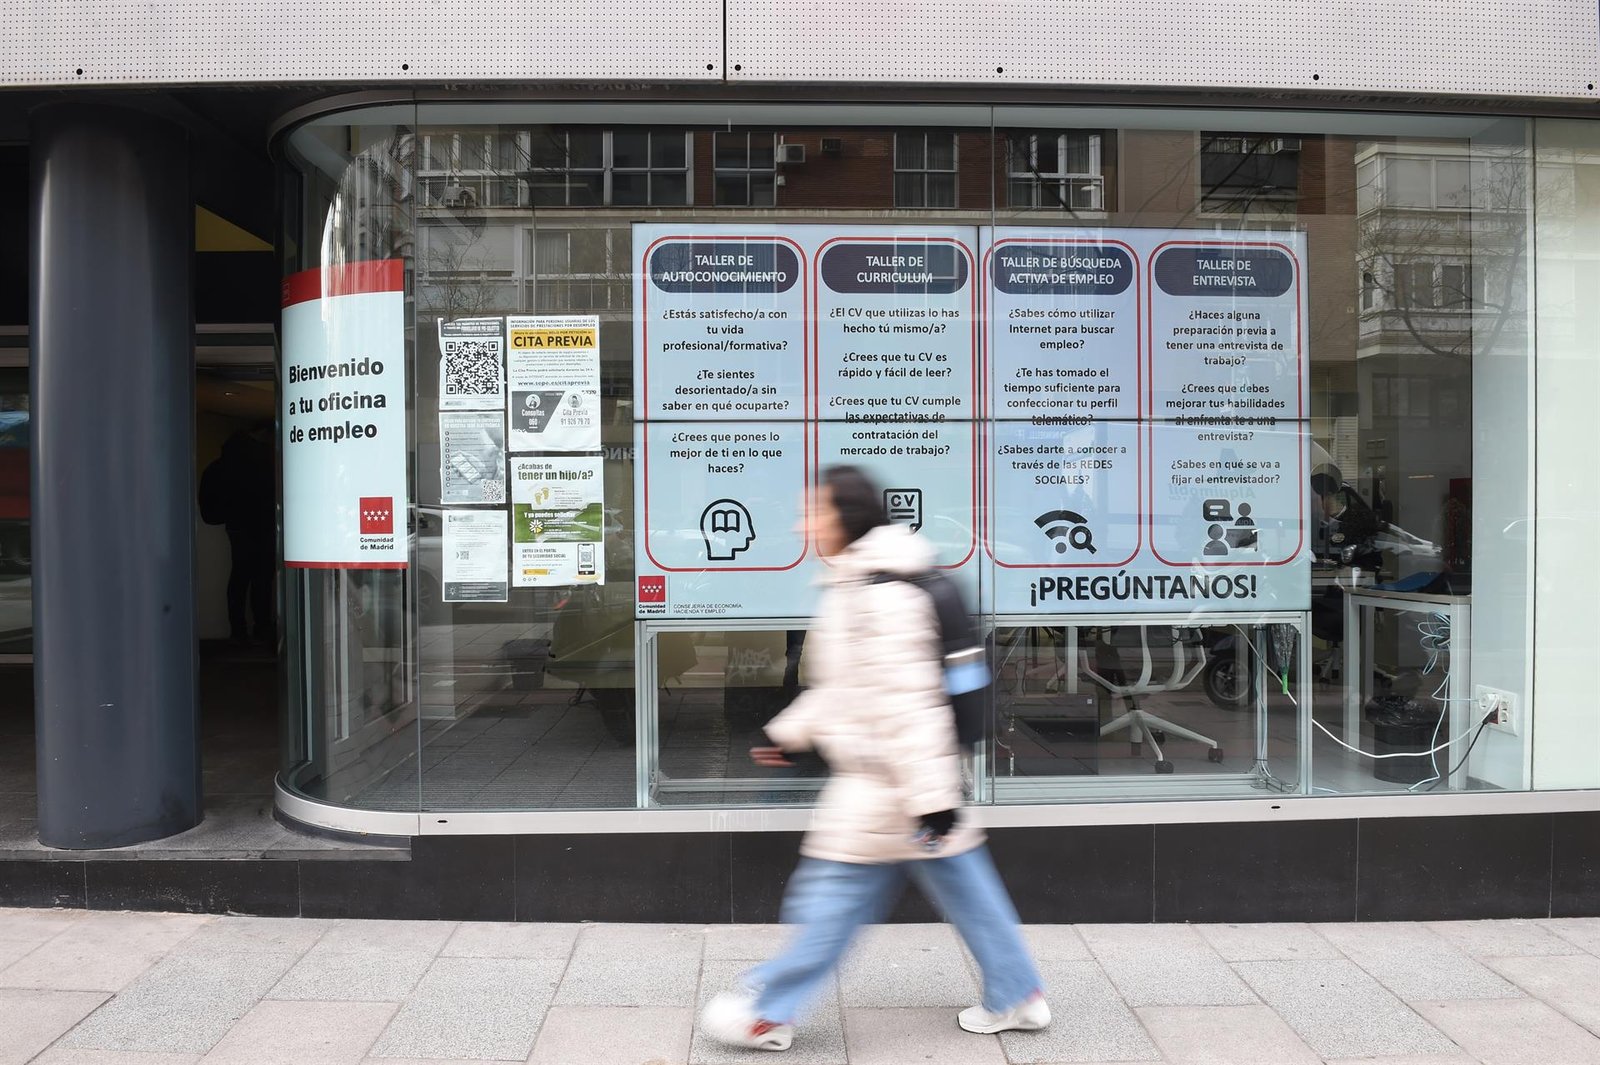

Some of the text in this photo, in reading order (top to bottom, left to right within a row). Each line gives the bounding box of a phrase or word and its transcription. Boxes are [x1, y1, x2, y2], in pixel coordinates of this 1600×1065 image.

[695, 255, 753, 266] TALLER DE
[866, 256, 924, 266] TALLER DE
[1001, 256, 1121, 270] TALLER DE BÚSQUEDA
[1196, 260, 1251, 271] TALLER DE
[662, 272, 786, 282] AUTOCONOCIMIENTO
[856, 272, 932, 282] CURRICULUM
[1009, 273, 1114, 284] ACTIVA DE EMPLEO
[1193, 275, 1256, 286] ENTREVISTA
[663, 309, 696, 320] ¿Estás
[700, 309, 765, 320] satisfecho/a
[1009, 308, 1115, 320] ¿Sabes cómo utilizar
[1189, 310, 1260, 322] ¿Haces alguna
[707, 325, 743, 334] tu vida
[844, 323, 946, 334] hecho tú mismo/a?
[1010, 324, 1114, 336] Internet para buscar
[1173, 325, 1233, 336] preparación
[1237, 326, 1267, 336] previa
[514, 336, 592, 346] CITA PREVIA
[663, 340, 788, 352] profesional/formativa?
[1040, 339, 1084, 350] empleo?
[1165, 340, 1193, 351] tener
[1218, 341, 1268, 350] entrevista
[1271, 341, 1283, 350] de
[1204, 356, 1246, 367] trabajo?
[290, 357, 384, 384] Bienvenido
[697, 370, 754, 380] ¿Te sientes
[839, 367, 952, 379] rápido y fácil de leer?
[1016, 368, 1108, 378] ¿Te has tomado el
[675, 385, 776, 396] desorientado/a sin
[1004, 383, 1120, 395] tiempo suficiente para
[1182, 384, 1270, 396] ¿Crees que debes
[290, 390, 386, 415] a tu oficina
[663, 401, 789, 412] saber en qué ocuparte?
[830, 396, 960, 408] ¿Crees que tu CV cumple
[1007, 398, 1117, 409] confeccionar tu perfil
[1166, 398, 1284, 410] mejorar tus habilidades
[845, 412, 945, 425] las expectativas de
[1032, 414, 1093, 426] telemático?
[290, 421, 377, 443] de empleo
[852, 430, 938, 439] contratación del
[1198, 431, 1254, 441] entrevista?
[840, 445, 950, 456] mercado de trabajo?
[998, 444, 1034, 455] ¿Sabes
[1037, 444, 1064, 454] darte
[708, 463, 744, 473] haces?
[1012, 460, 1113, 470] través de las REDES
[518, 471, 543, 480] tener
[560, 470, 593, 480] hijo/a?
[1035, 475, 1089, 485] SOCIALES?
[1172, 474, 1280, 485] fijar el entrevistador?
[891, 495, 915, 507] CV
[1030, 570, 1257, 606] ¡PREGÚNTANOS!
